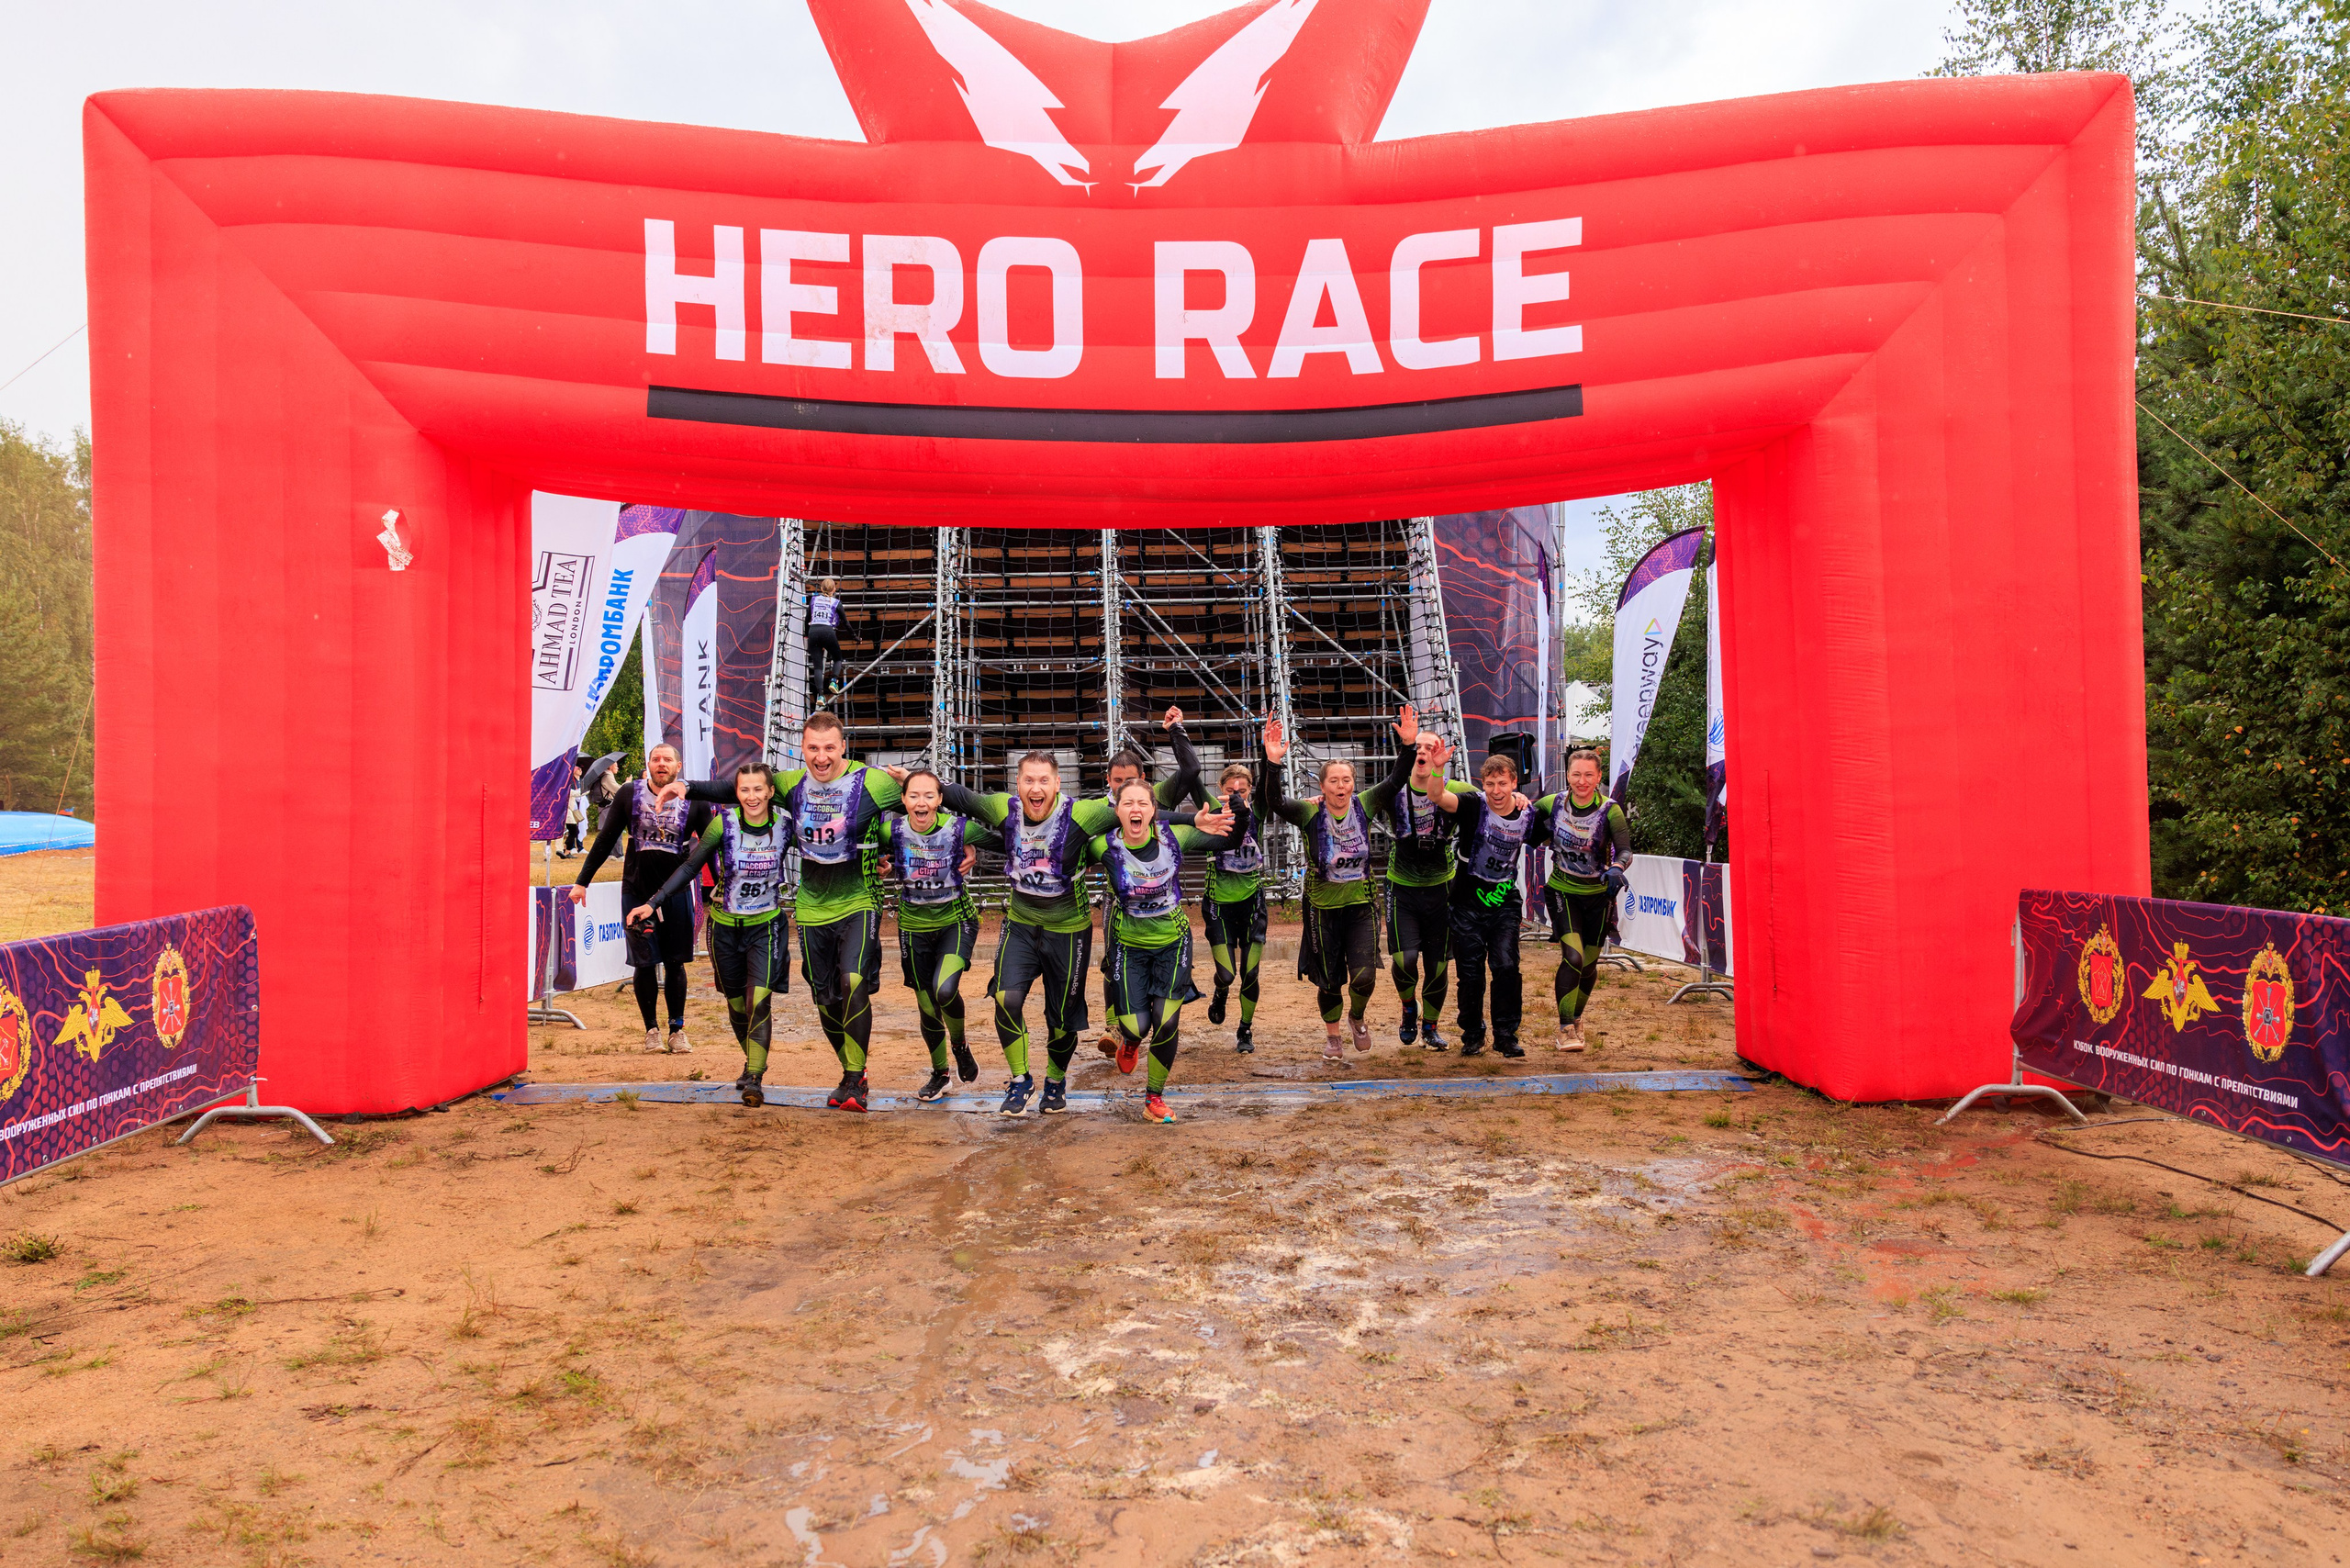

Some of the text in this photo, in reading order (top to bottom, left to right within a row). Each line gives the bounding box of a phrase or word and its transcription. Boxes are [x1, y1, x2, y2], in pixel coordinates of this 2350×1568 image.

[644, 217, 1583, 378] HERO RACE
[537, 559, 577, 685] AHMAD TEA
[569, 600, 582, 644] LONDON
[698, 640, 712, 741] TANK
[740, 860, 778, 869] МАССОВЫЙ
[804, 827, 835, 845] 913
[1336, 857, 1363, 868] 970
[0, 1063, 197, 1141] ВООРУЖЕННЫХ СИЛ ПО ГОНКАМ С ПРЕПЯТСТВИЯМИ
[2073, 1040, 2298, 1108] КУБОК ВООРУЖЕННЫХ СИЛ ПО ГОНКАМ С ПРЕПЯТСТВИЯМИ
